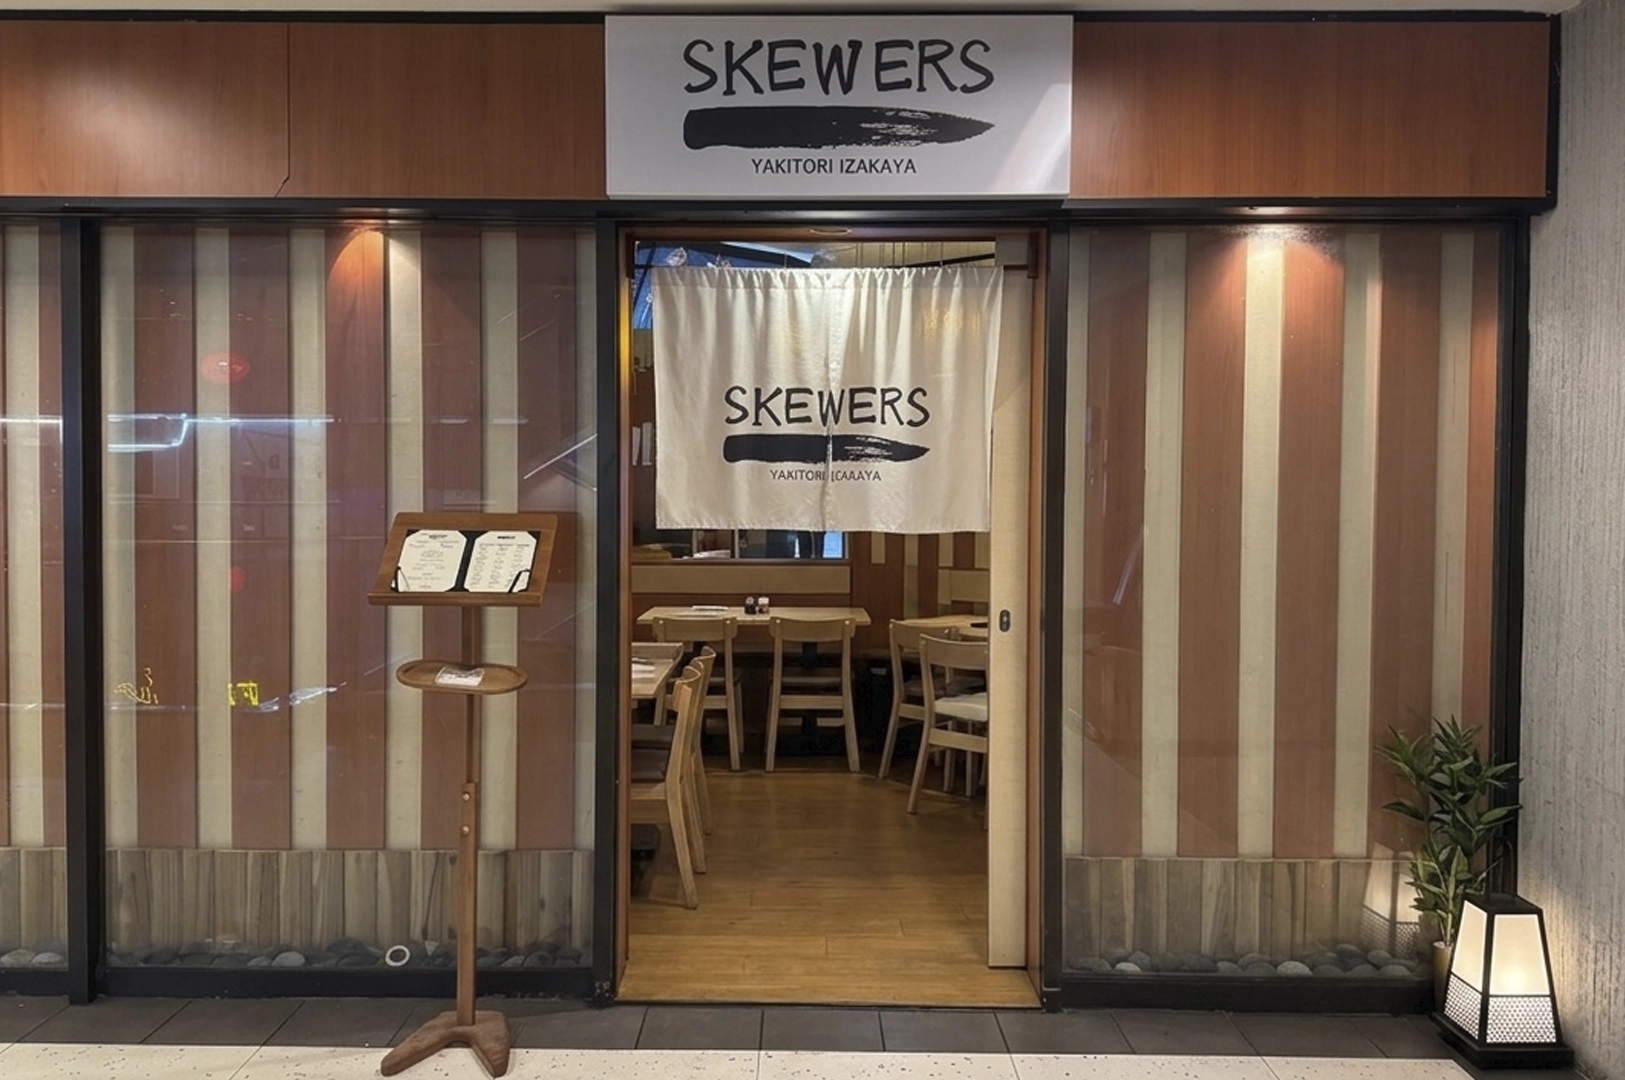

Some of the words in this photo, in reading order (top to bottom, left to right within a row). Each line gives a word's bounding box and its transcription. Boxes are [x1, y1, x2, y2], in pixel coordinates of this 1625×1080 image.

[683, 39, 995, 96] SKEWERS
[751, 158, 833, 174] YAKITORI
[839, 158, 917, 174] IZAKAYA
[724, 385, 930, 428] SKEWERS
